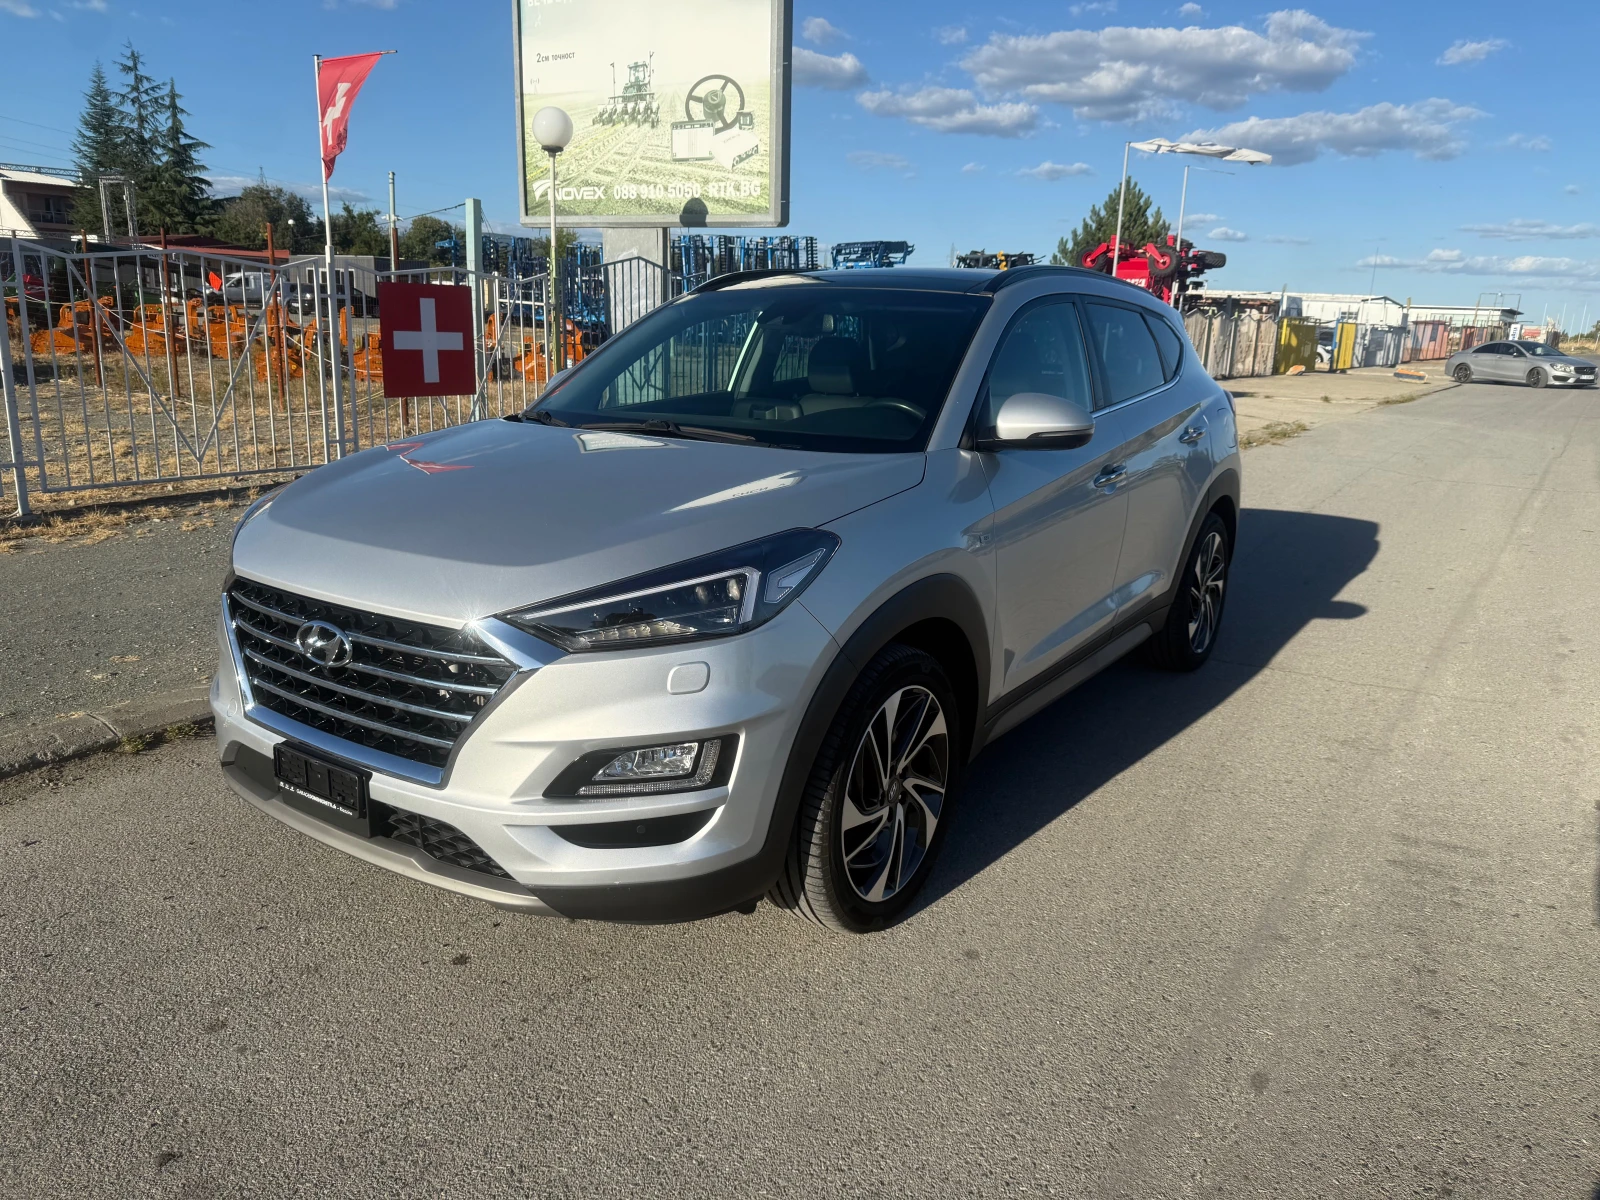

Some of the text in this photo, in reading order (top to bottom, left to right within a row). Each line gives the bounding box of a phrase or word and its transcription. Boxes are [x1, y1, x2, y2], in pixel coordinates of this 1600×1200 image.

[536, 51, 576, 63] 2см точност
[613, 181, 702, 200] 088 910 5050
[708, 180, 761, 198] RTK.BG
